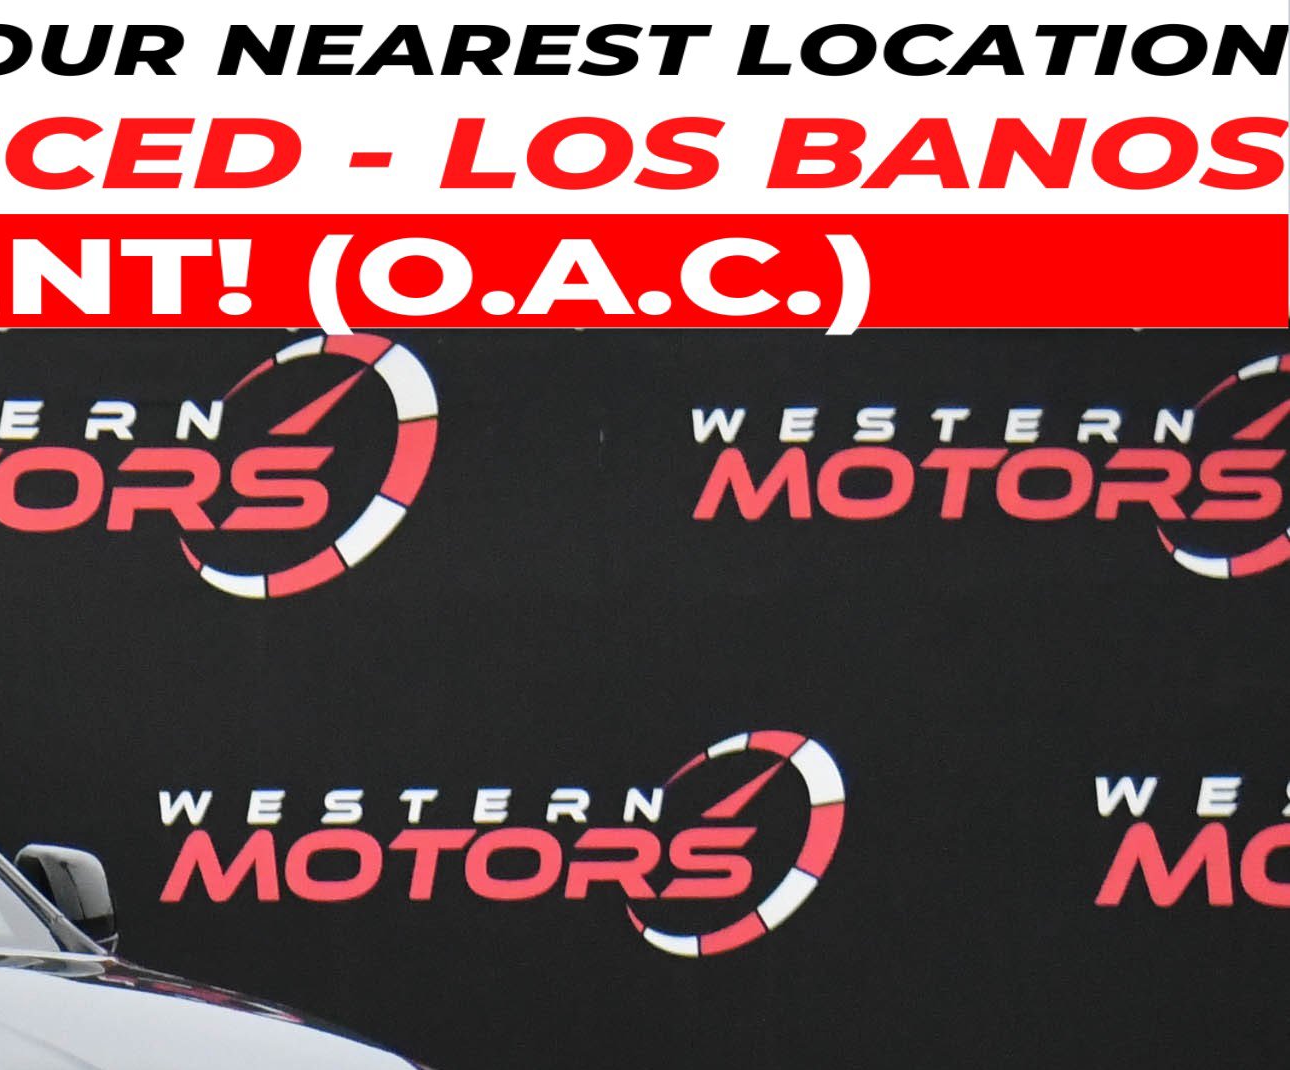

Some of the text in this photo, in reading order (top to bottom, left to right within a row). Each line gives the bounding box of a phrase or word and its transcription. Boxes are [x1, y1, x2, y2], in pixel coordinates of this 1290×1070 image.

[692, 407, 1194, 443] WESTERN
[693, 446, 1287, 521] MOTORS
[159, 788, 664, 825] WESTERN
[160, 827, 757, 903] MOTORS
